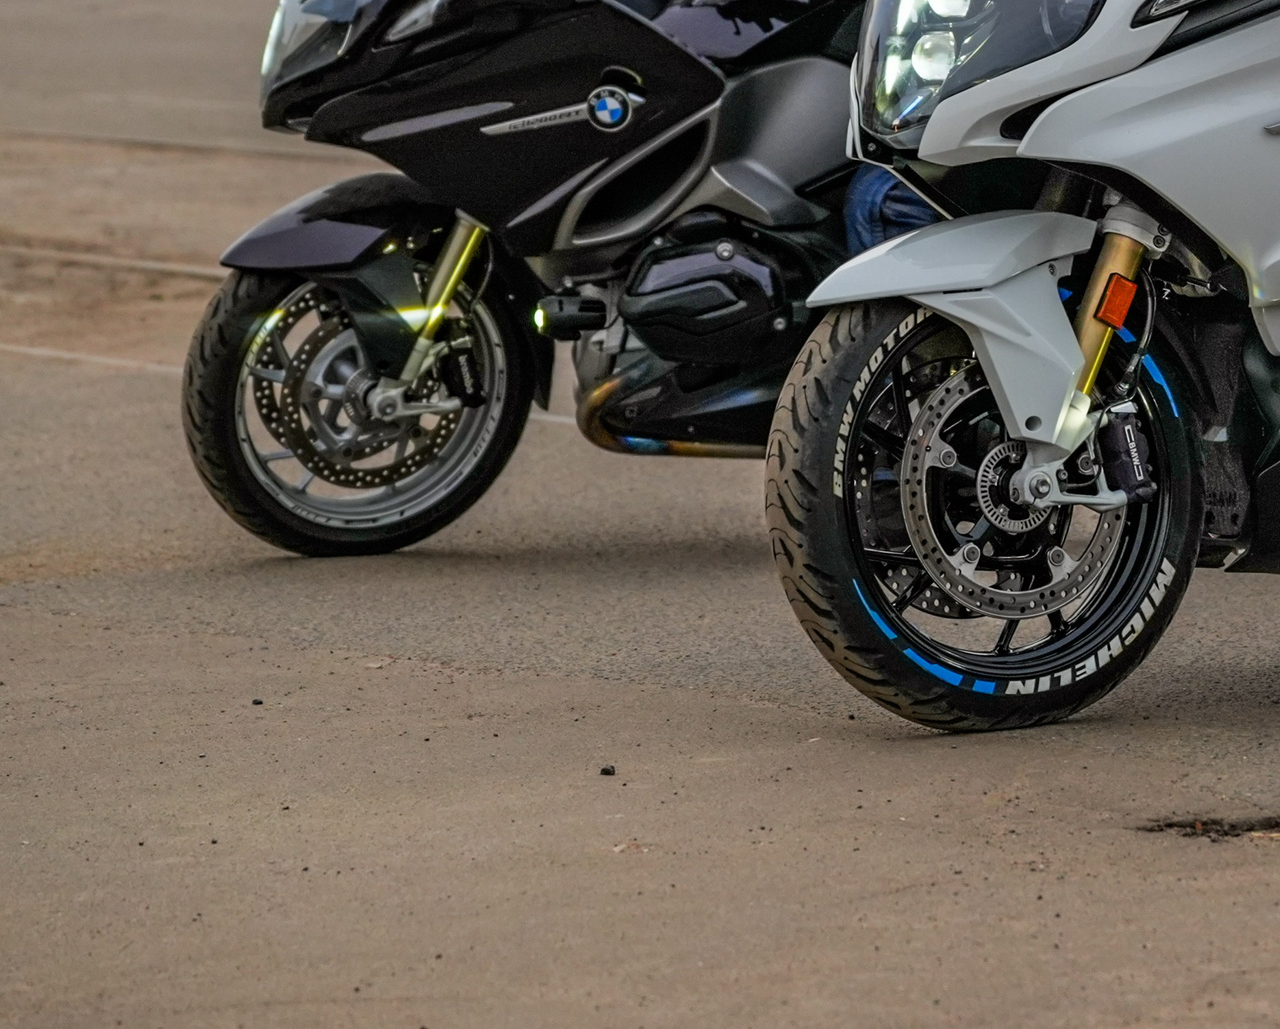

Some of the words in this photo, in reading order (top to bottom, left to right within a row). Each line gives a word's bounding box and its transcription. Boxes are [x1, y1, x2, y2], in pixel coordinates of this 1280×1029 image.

[590, 90, 624, 106] BMW
[833, 400, 854, 498] BMW
[1128, 442, 1141, 465] BMW
[1005, 557, 1176, 695] MICHELIN
